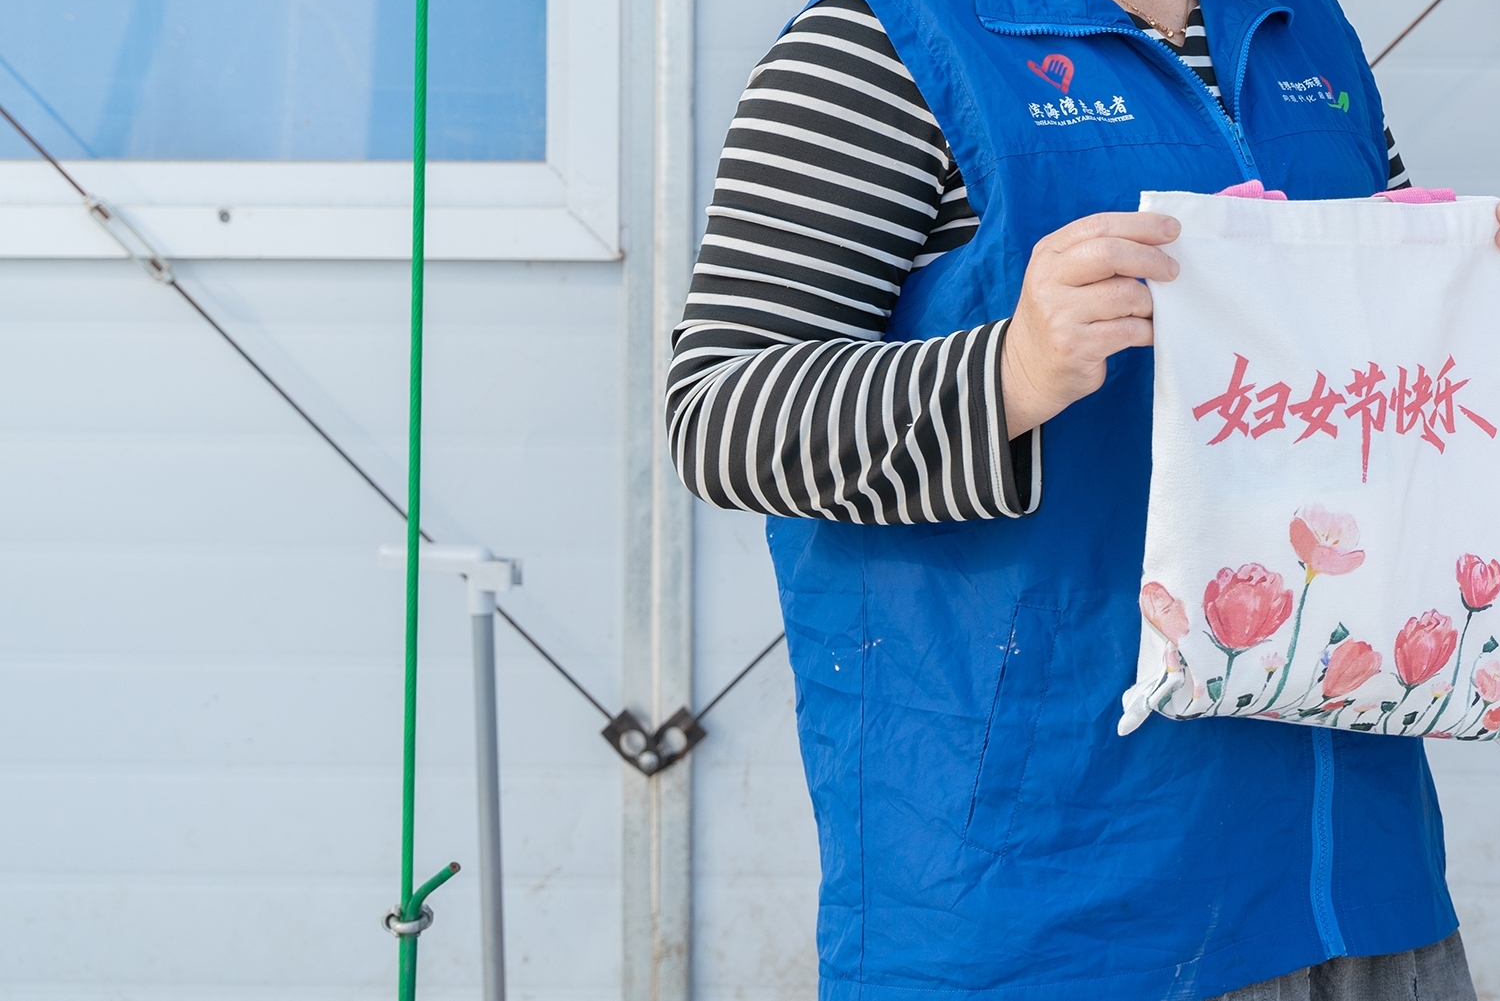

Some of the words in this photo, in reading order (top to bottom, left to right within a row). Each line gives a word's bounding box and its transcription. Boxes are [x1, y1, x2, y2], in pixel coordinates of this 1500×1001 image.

[1028, 96, 1127, 119] 滨海湾志愿者
[1192, 352, 1497, 484] 妇女节快乐
